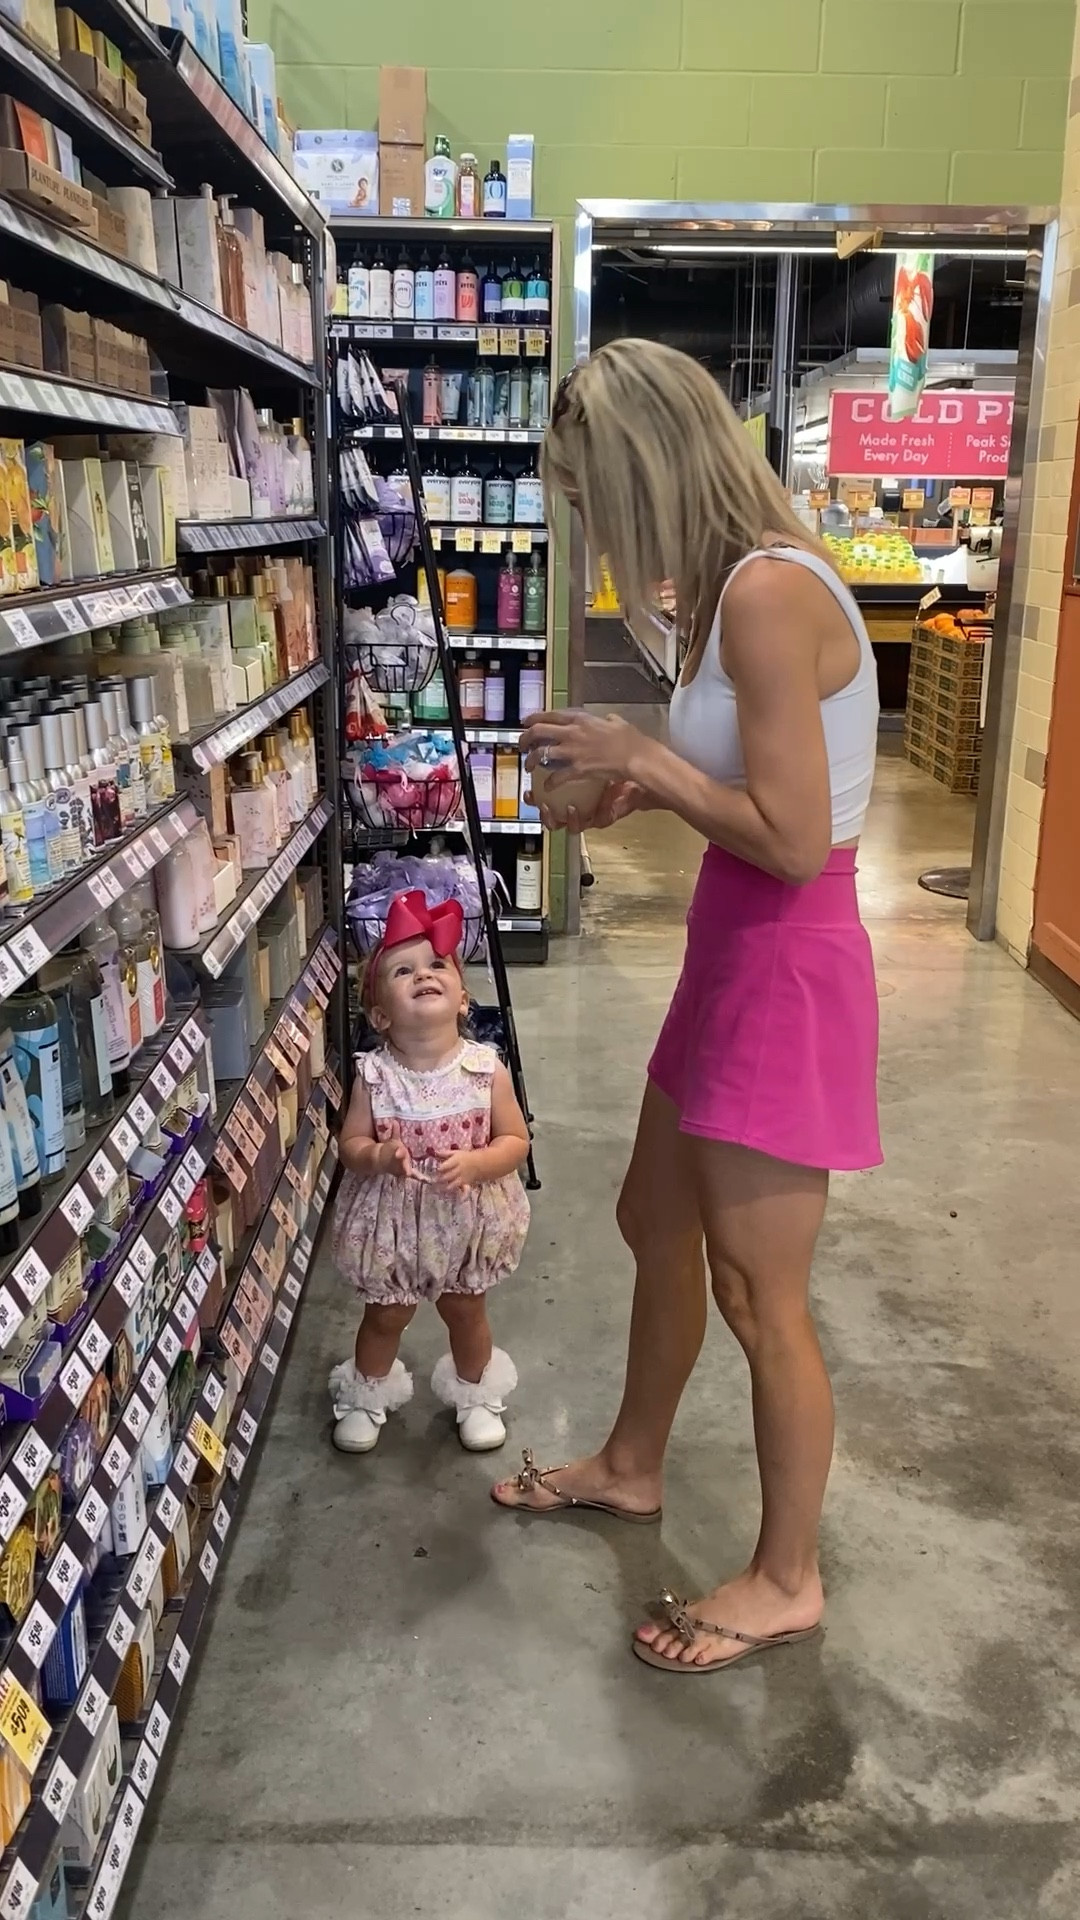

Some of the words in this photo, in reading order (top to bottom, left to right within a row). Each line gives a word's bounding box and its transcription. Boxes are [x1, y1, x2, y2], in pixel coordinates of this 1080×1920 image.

[433, 168, 448, 177] Spry
[976, 400, 1014, 425] P
[859, 434, 897, 447] Made
[901, 434, 935, 447] Fresh
[966, 434, 996, 447] Peak
[863, 449, 899, 465] Every
[902, 449, 929, 465] Day
[978, 450, 1008, 464] Prod
